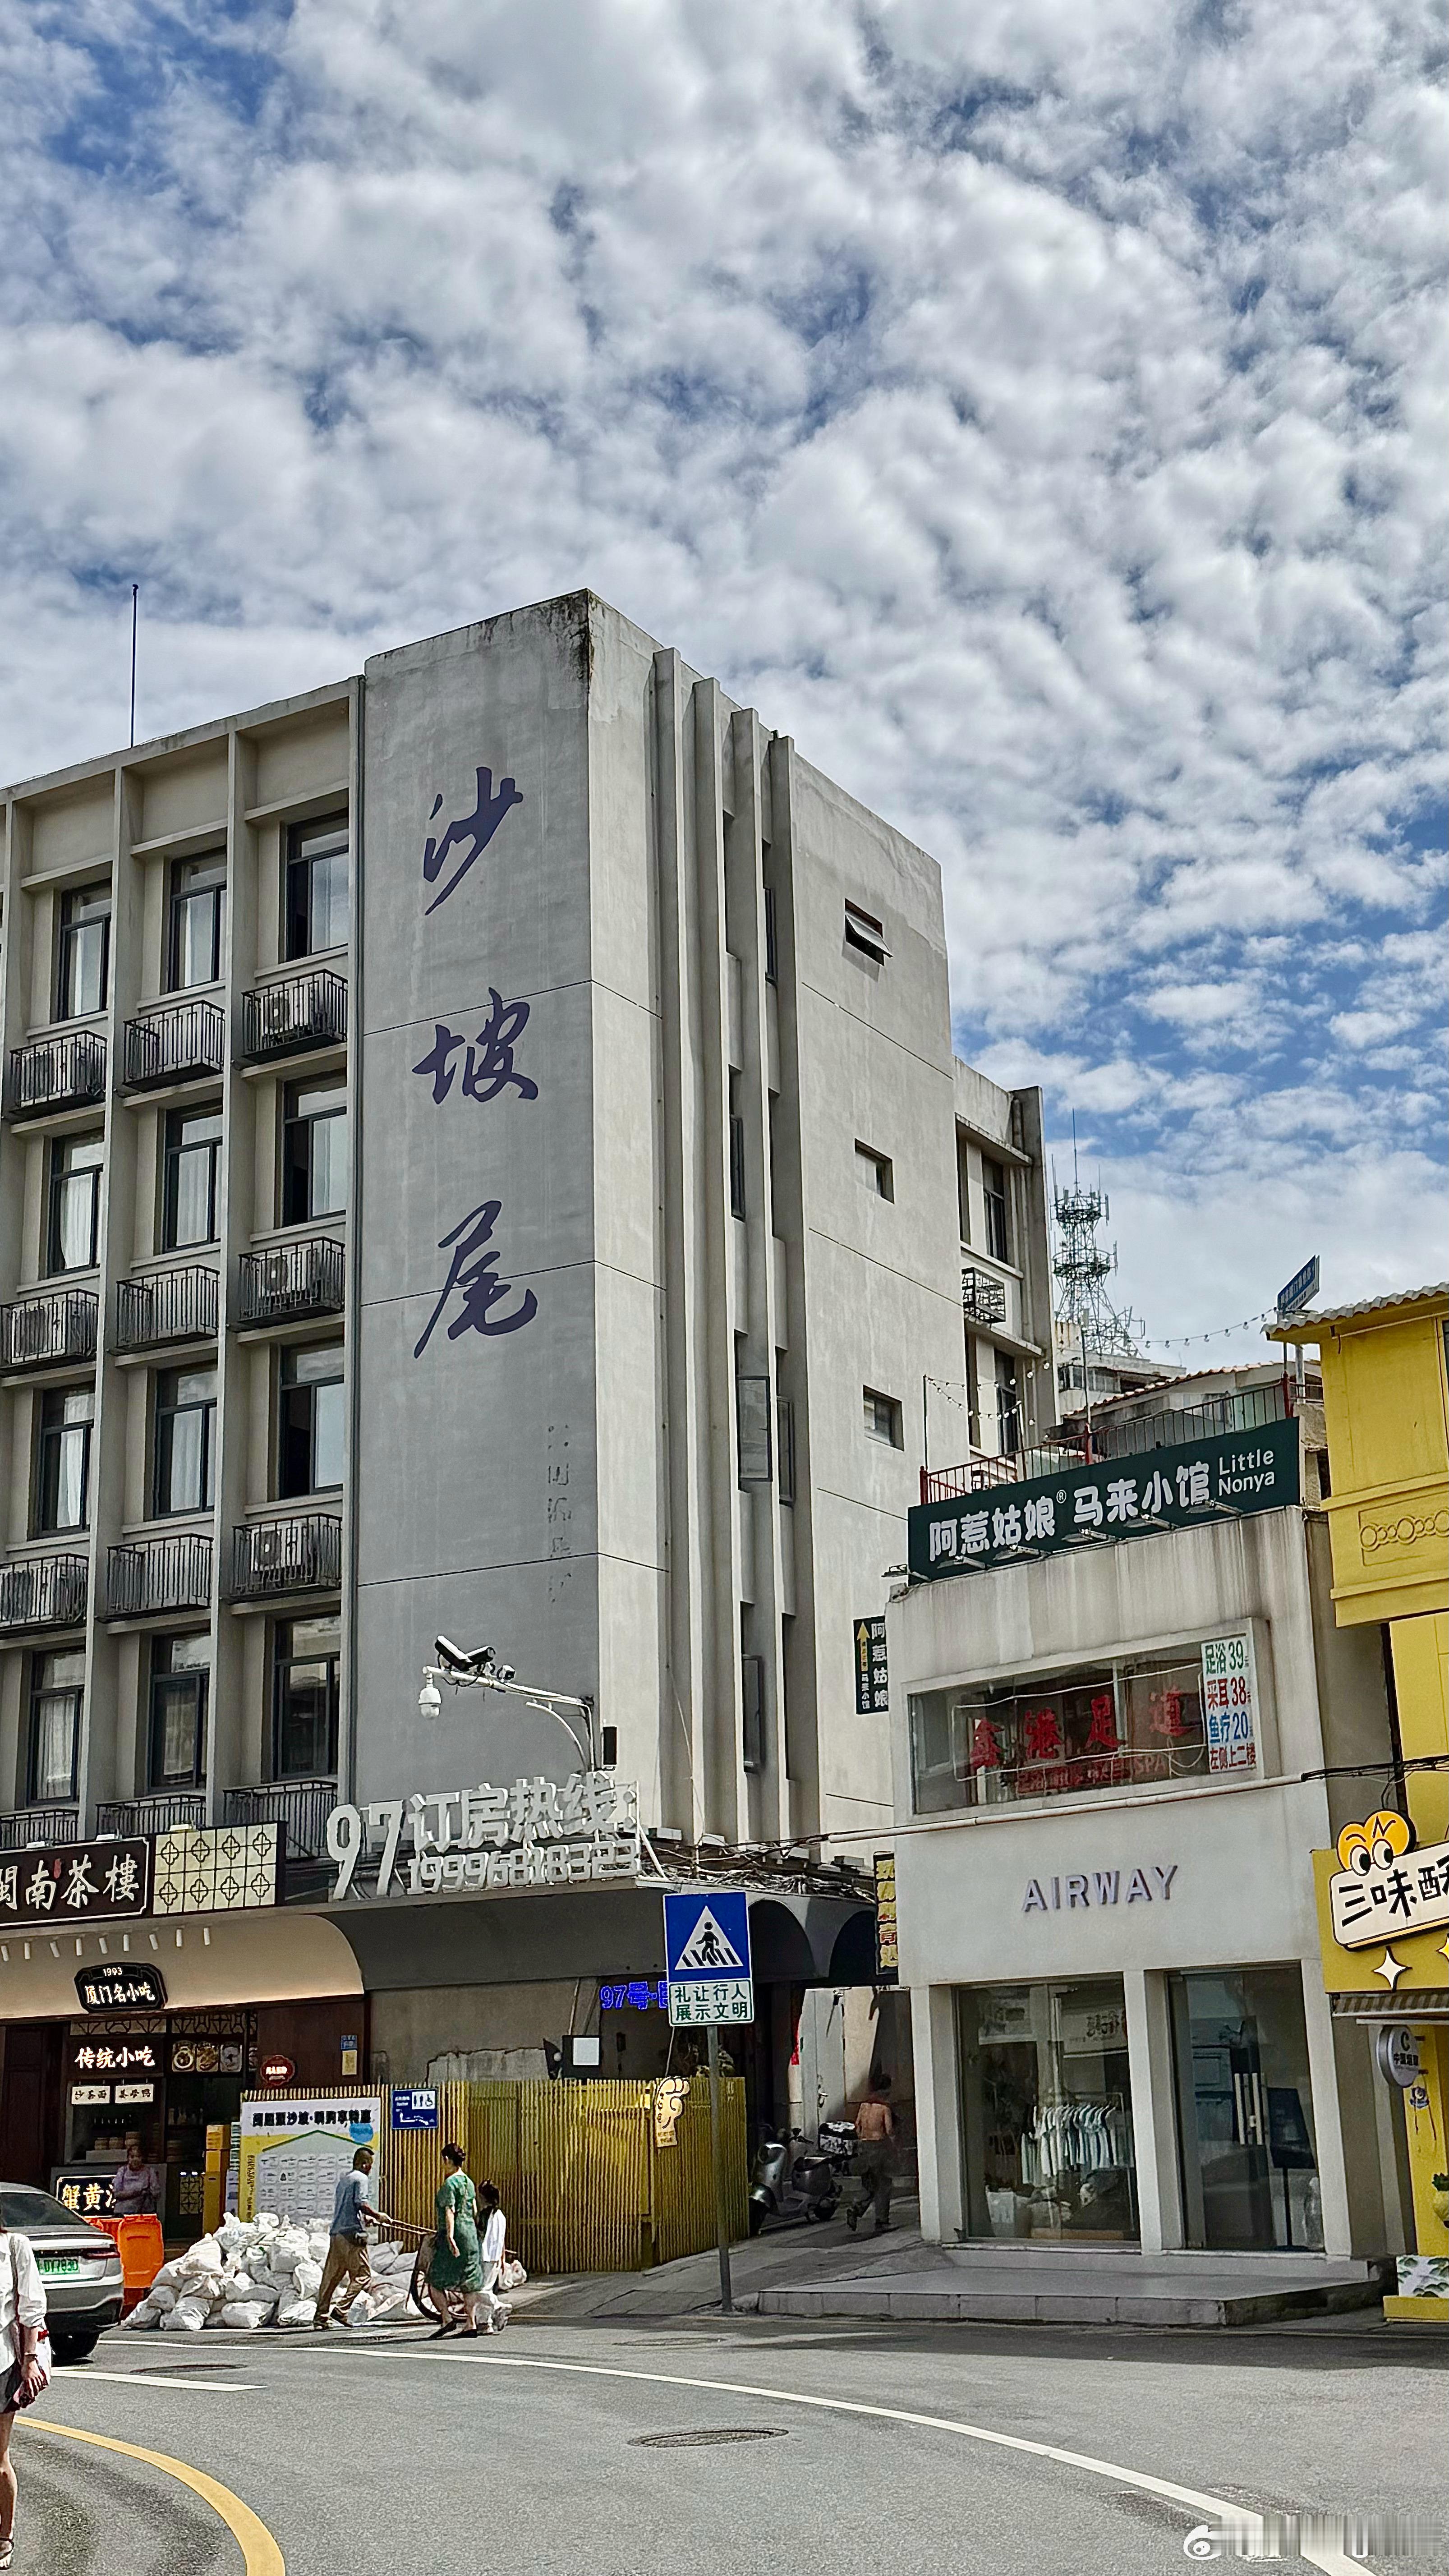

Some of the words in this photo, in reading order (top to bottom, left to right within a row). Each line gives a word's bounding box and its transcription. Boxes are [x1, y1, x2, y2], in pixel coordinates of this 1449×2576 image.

[412, 767, 538, 1358] 沙坡尾
[1219, 1449, 1274, 1475] Little
[1074, 1462, 1210, 1527] 马来小馆
[1219, 1471, 1275, 1497] Nonya
[406, 1839, 639, 1894] 19996818323
[1021, 1865, 1178, 1912] AIRWAY
[84, 1982, 156, 2004] 厦门名小吃
[675, 1983, 746, 2003] 礼让行人
[676, 2001, 748, 2021] 展示文明
[74, 2045, 156, 2069] 传统小吃
